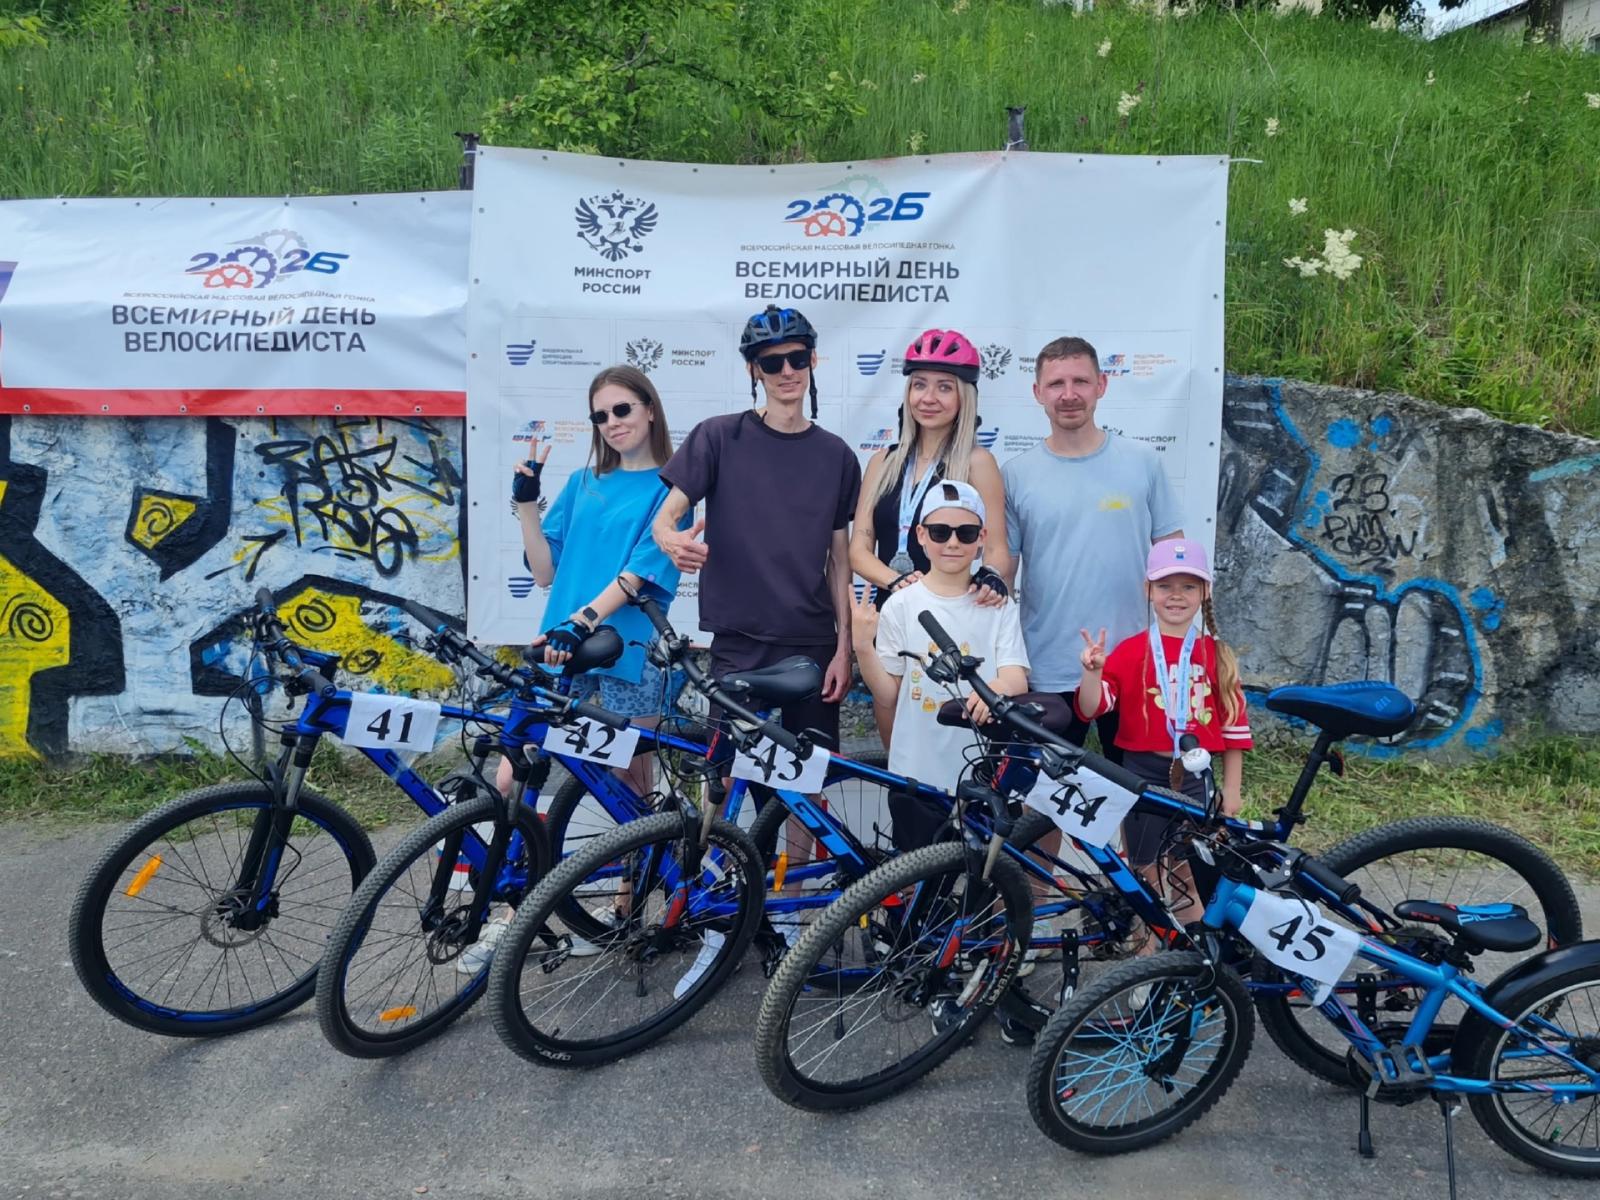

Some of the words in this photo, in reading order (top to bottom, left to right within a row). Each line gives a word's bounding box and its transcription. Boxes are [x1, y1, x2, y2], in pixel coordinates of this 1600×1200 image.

[814, 243, 861, 251] МАССОВАЯ
[862, 241, 927, 250] ВЕЛОСИПЕДНАЯ
[929, 241, 956, 250] ГОНКА
[573, 265, 652, 281] МИНСПОРТ
[735, 257, 890, 279] ВСЕМИРНЫЙ
[896, 260, 961, 281] ДЕНЬ
[582, 282, 642, 296] РОССИИ
[744, 281, 950, 304] ВЕЛОСИПЕДИСТА
[112, 304, 293, 328] ВСЕМИРНЫЙ
[300, 305, 377, 327] ДЕНЬ
[124, 330, 367, 354] ВЕЛОСИПЕДИСТА
[671, 349, 717, 358] МИНСПОРТ
[671, 358, 706, 367] РОССИИ
[366, 708, 415, 744] 41
[564, 717, 617, 760] 42
[749, 736, 804, 782] 43
[1049, 784, 1109, 828] 44
[1267, 914, 1337, 963] 45
